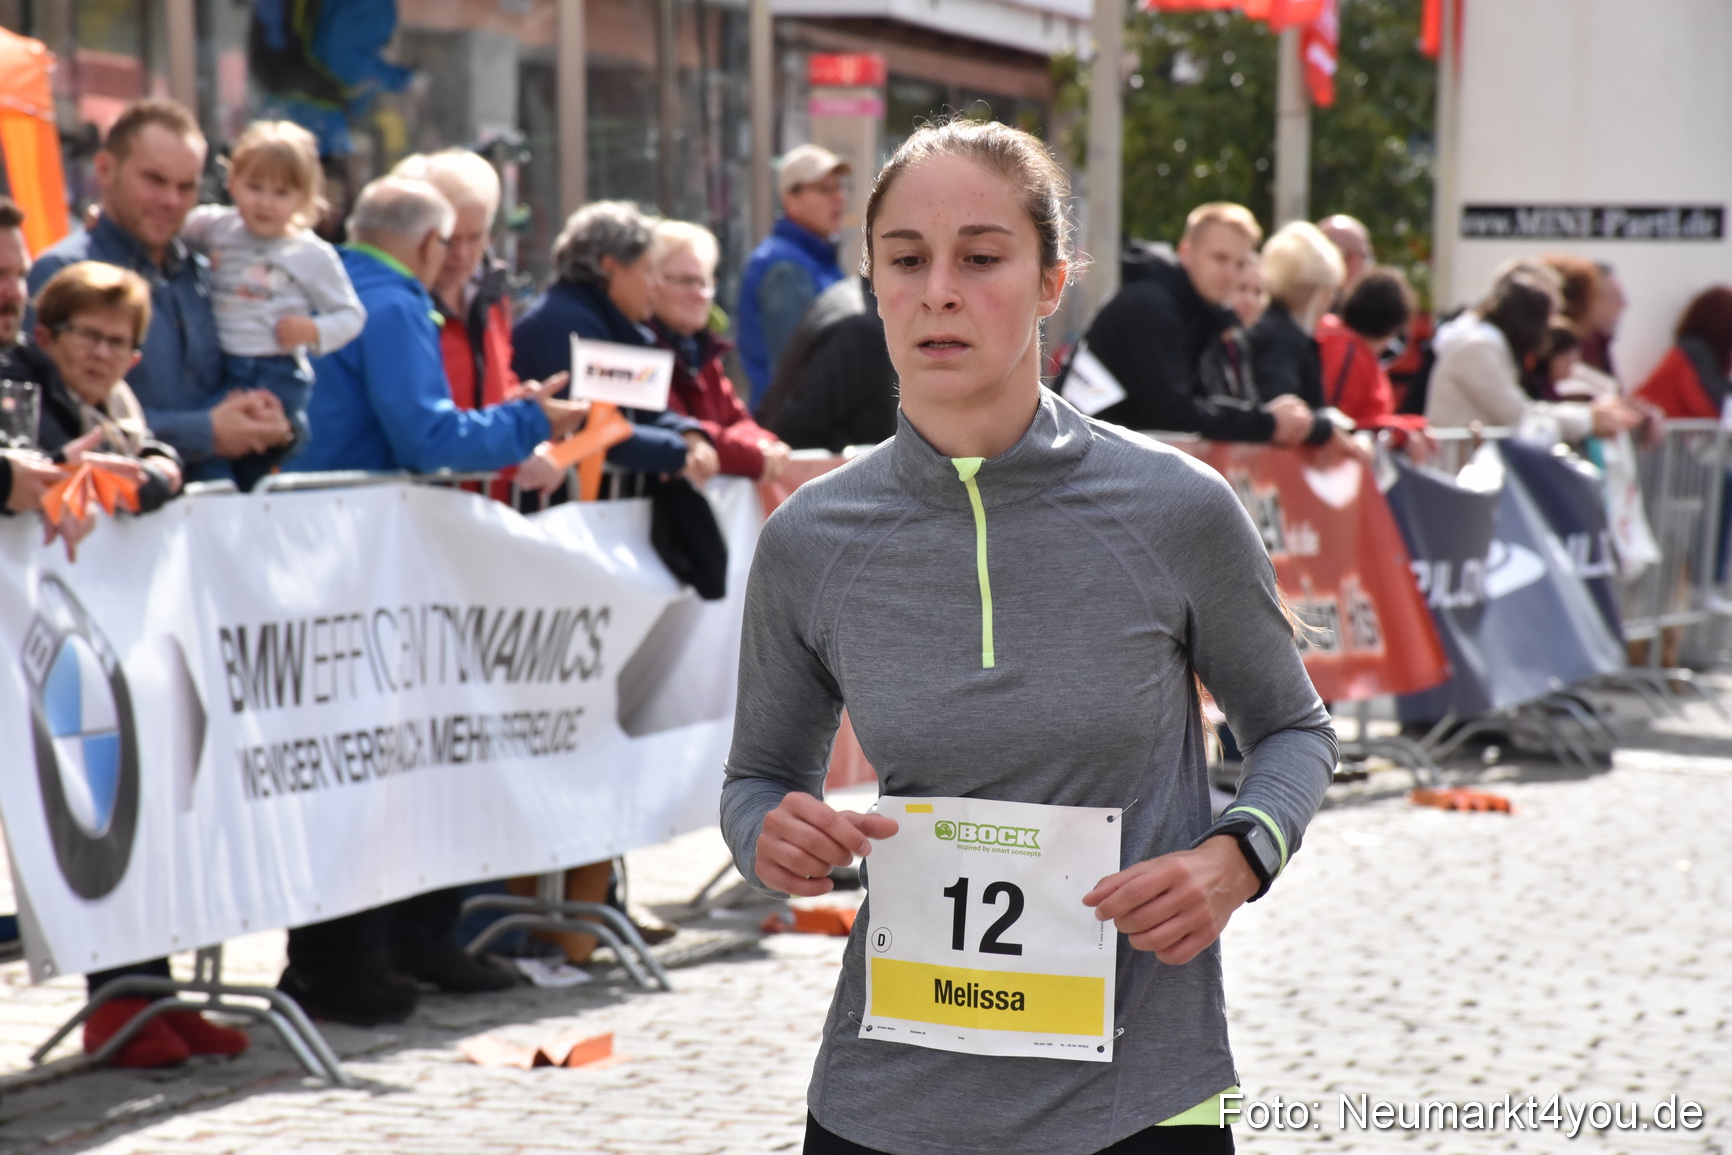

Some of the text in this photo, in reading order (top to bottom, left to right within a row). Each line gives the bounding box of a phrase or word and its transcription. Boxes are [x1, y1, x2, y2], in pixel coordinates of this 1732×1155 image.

[219, 619, 307, 714] BMW
[956, 843, 981, 852] inspired
[1011, 849, 1041, 857] concepts
[958, 822, 1041, 849] BOCK
[943, 876, 1025, 956] 12
[877, 933, 886, 947] D
[934, 978, 1026, 1011] Melissa
